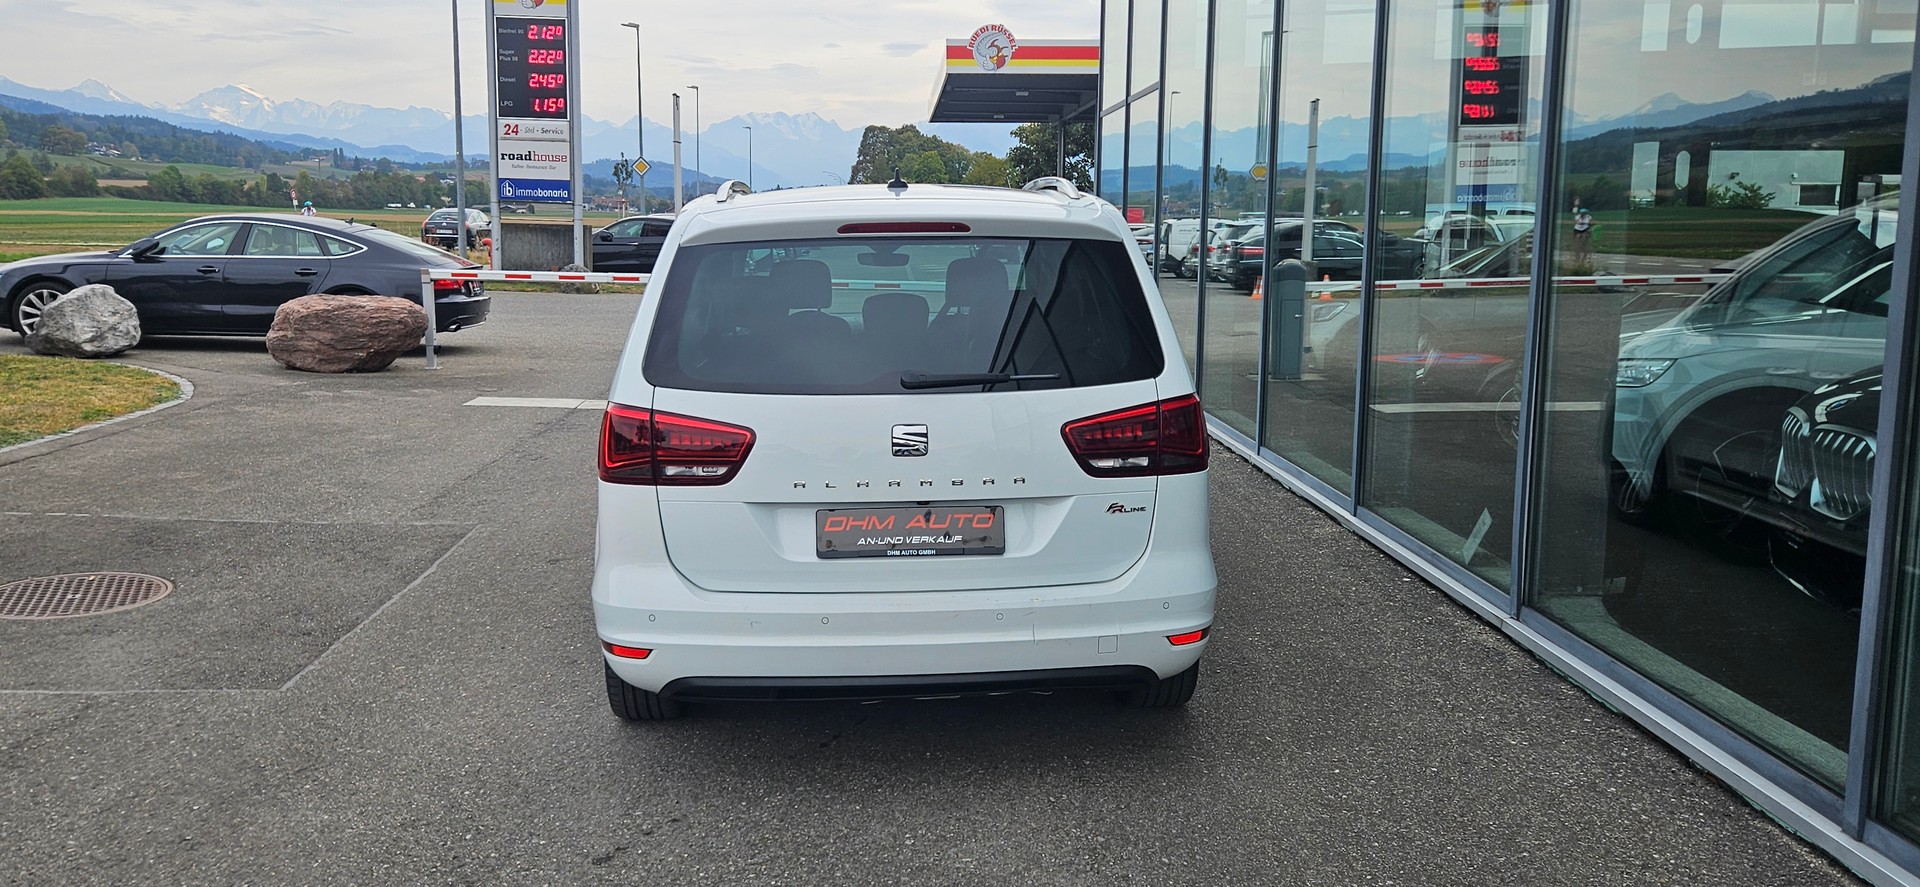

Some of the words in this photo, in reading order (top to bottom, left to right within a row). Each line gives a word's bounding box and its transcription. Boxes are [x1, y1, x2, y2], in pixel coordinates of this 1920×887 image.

[968, 26, 990, 49] RUEDI
[991, 24, 1017, 51] RÜSSEL
[503, 124, 519, 136] 24
[500, 151, 568, 163] roadhouse
[503, 182, 513, 196] ib
[515, 187, 568, 198] immobonaria
[793, 476, 1027, 489] ALHAMBRA
[823, 515, 896, 532] DHM
[905, 513, 996, 529] AUTO
[906, 535, 963, 545] VERKAUF
